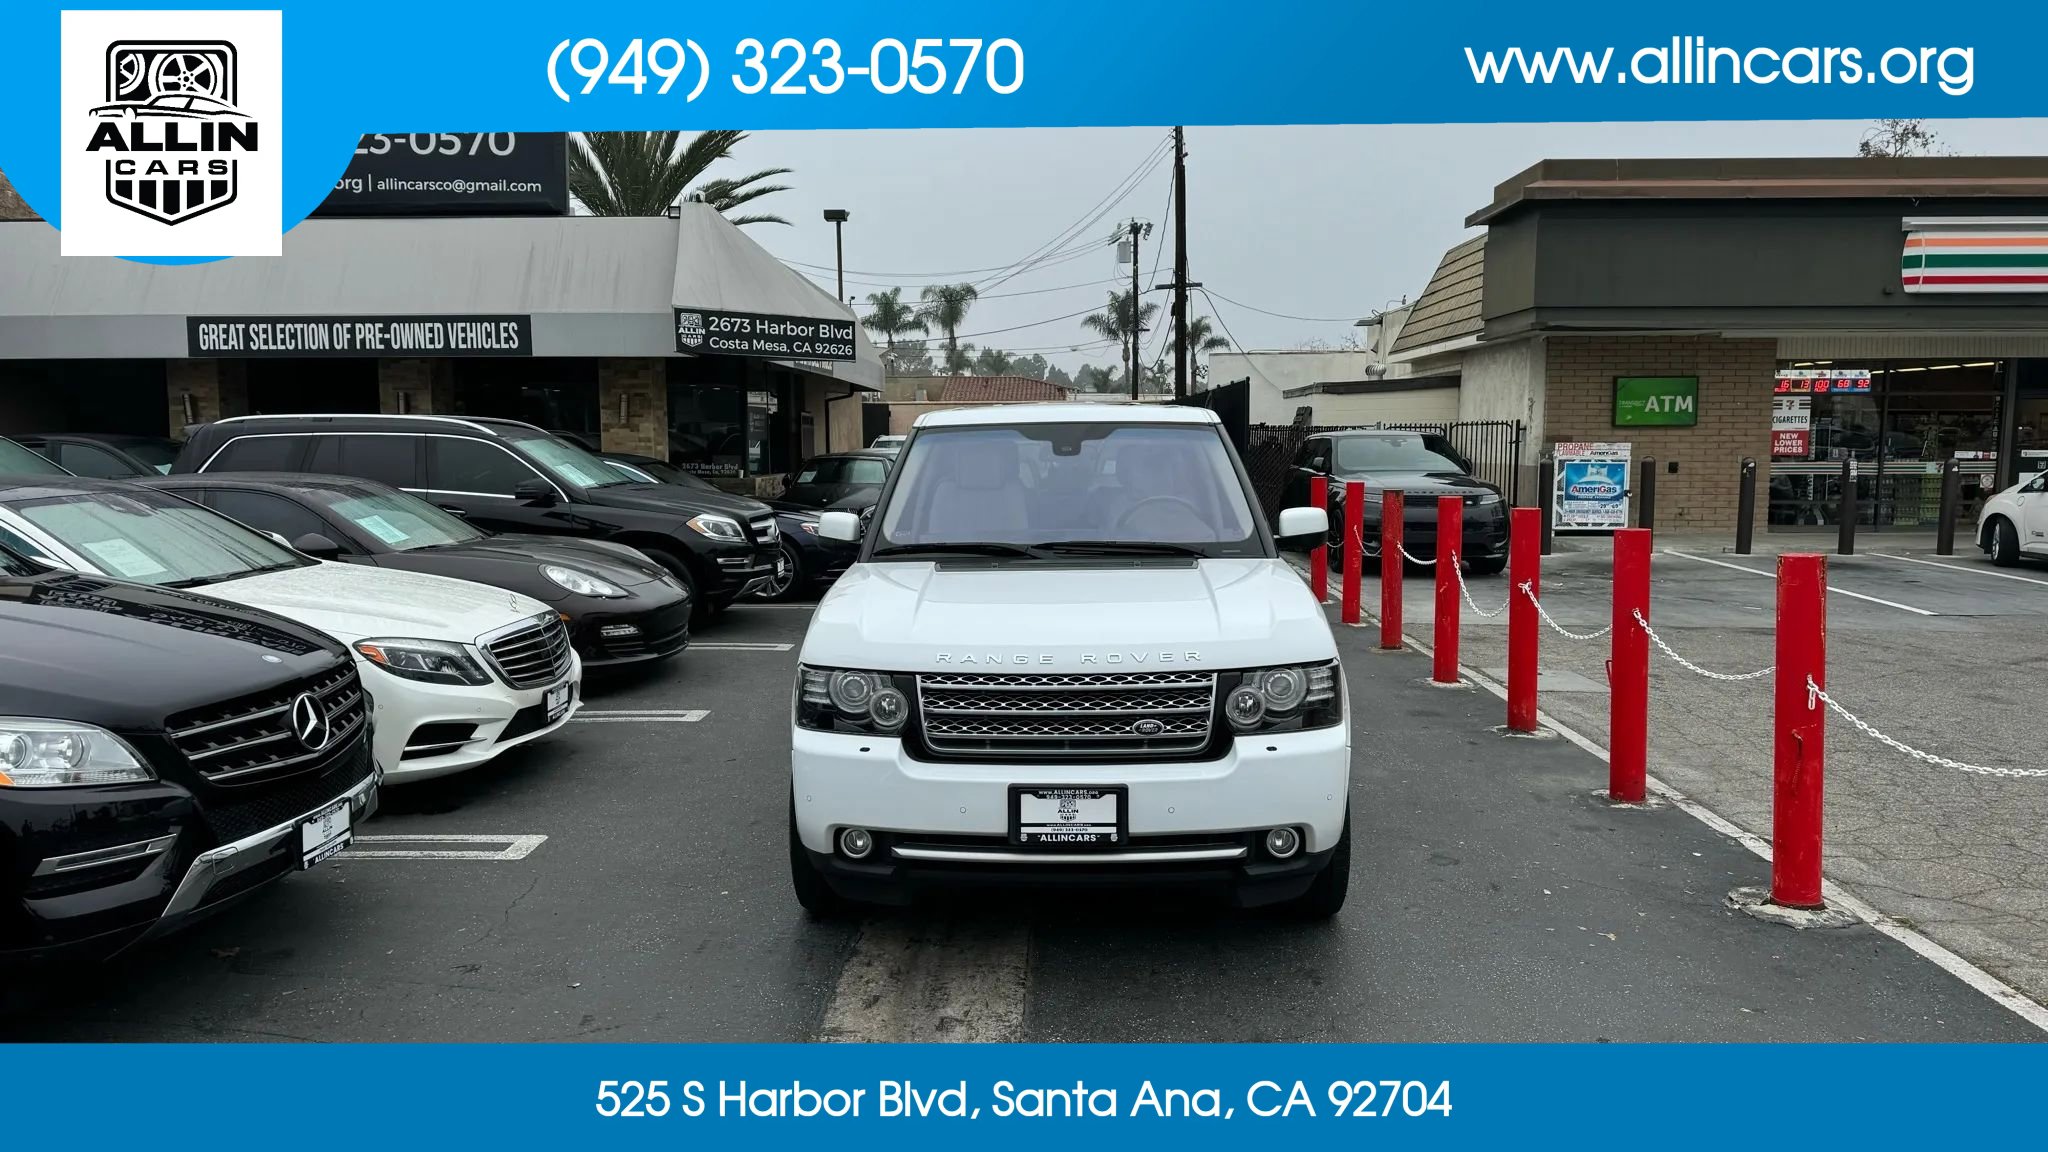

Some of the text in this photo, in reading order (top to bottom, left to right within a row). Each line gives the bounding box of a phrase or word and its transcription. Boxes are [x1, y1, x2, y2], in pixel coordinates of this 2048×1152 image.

[377, 177, 542, 193] allincarsco@gmail.com
[709, 316, 853, 339] 2673 Harbor Blvd
[199, 322, 518, 350] GREAT SELECTION OF PRE-OWNED VEHICLES
[709, 338, 853, 356] Costa Mesa, CA 92626
[1645, 395, 1693, 413] ATM
[1772, 415, 1808, 424] CIGARETTES
[1779, 432, 1799, 440] NEW
[1774, 439, 1803, 447] LOWER
[1773, 446, 1803, 454] PRICES
[1571, 485, 1617, 494] AmeriGas
[935, 651, 1202, 664] RANGE ROVER
